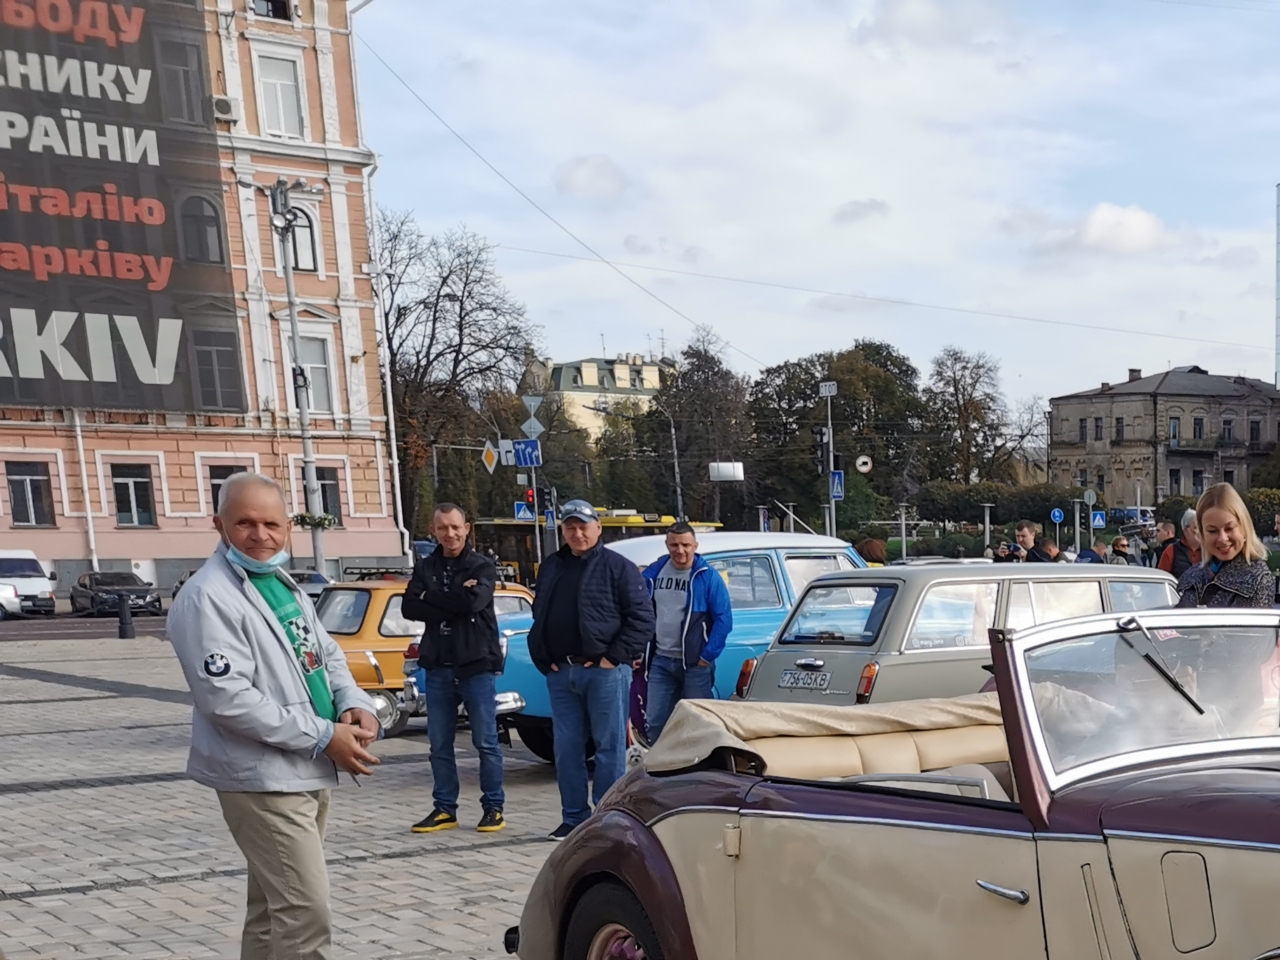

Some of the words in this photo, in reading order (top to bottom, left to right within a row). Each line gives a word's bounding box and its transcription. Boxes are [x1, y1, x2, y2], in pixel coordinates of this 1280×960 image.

[0, 50, 152, 104] НИКУ
[0, 108, 160, 166] РАЇНИ
[0, 240, 174, 291] арківу
[0, 308, 183, 385] KIV
[675, 578, 690, 593] NA
